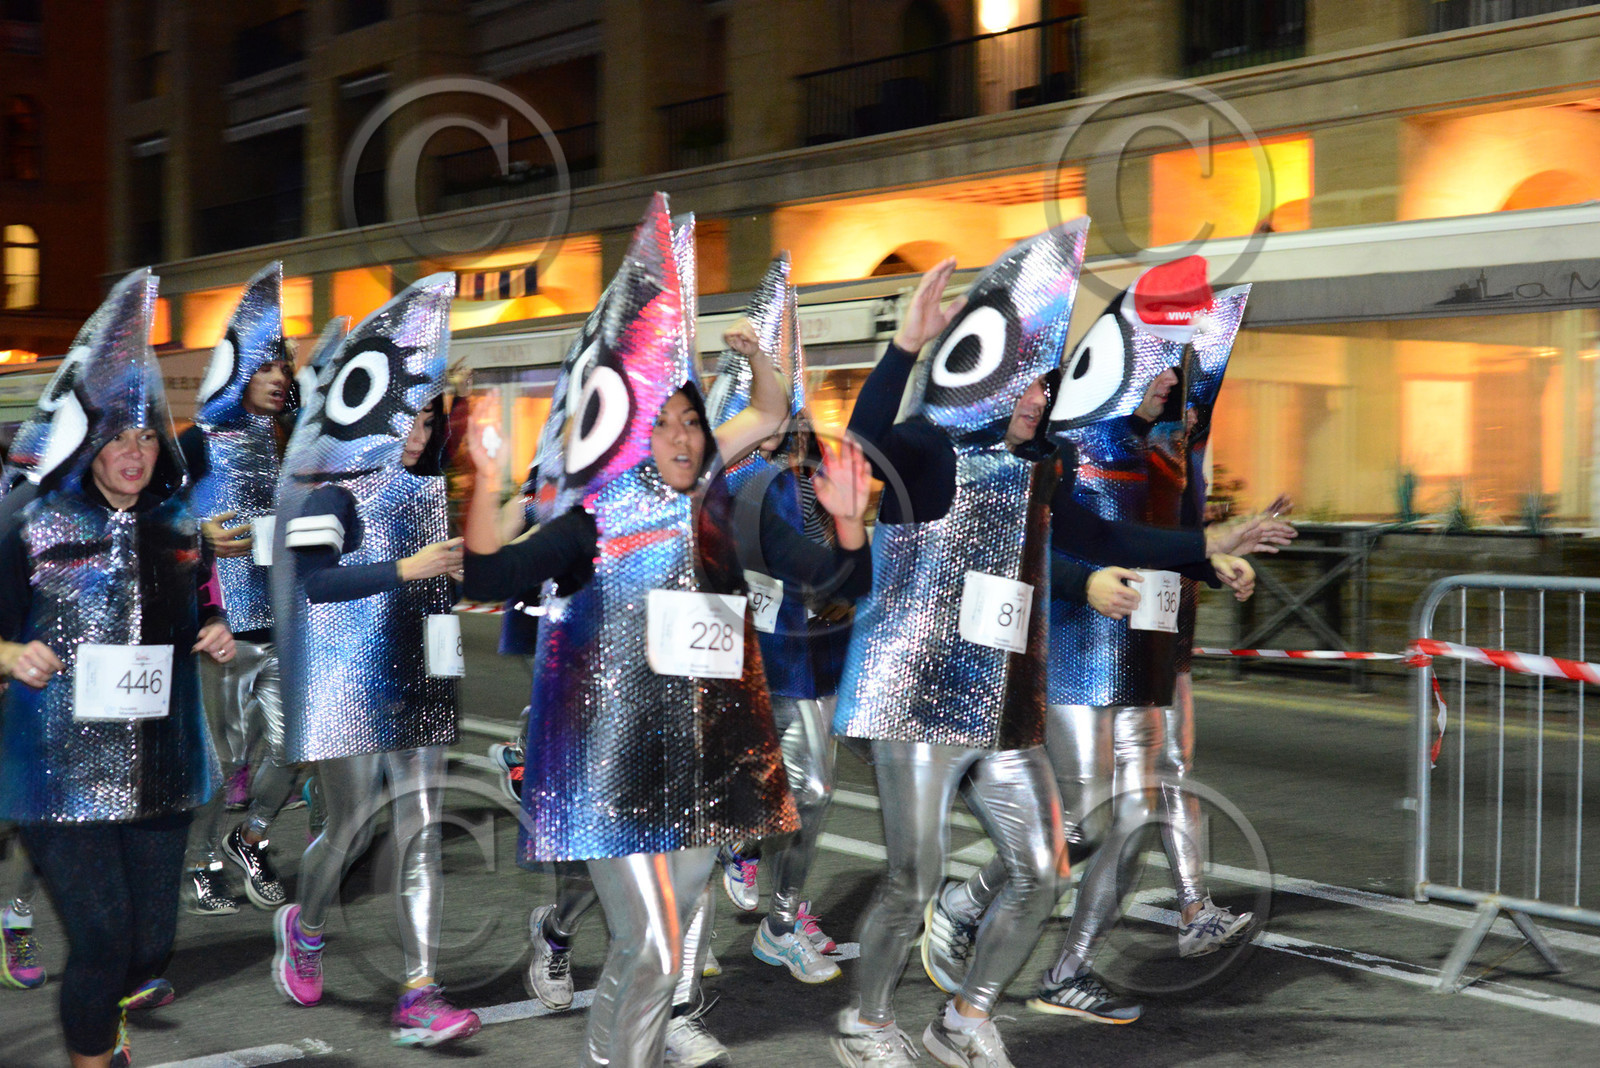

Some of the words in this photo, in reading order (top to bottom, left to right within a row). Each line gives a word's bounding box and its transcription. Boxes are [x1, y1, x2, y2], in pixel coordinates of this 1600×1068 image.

[1168, 311, 1192, 321] VIVA
[750, 592, 774, 613] 97
[1157, 591, 1178, 613] 136
[689, 621, 734, 652] 228
[116, 669, 163, 695] 446
